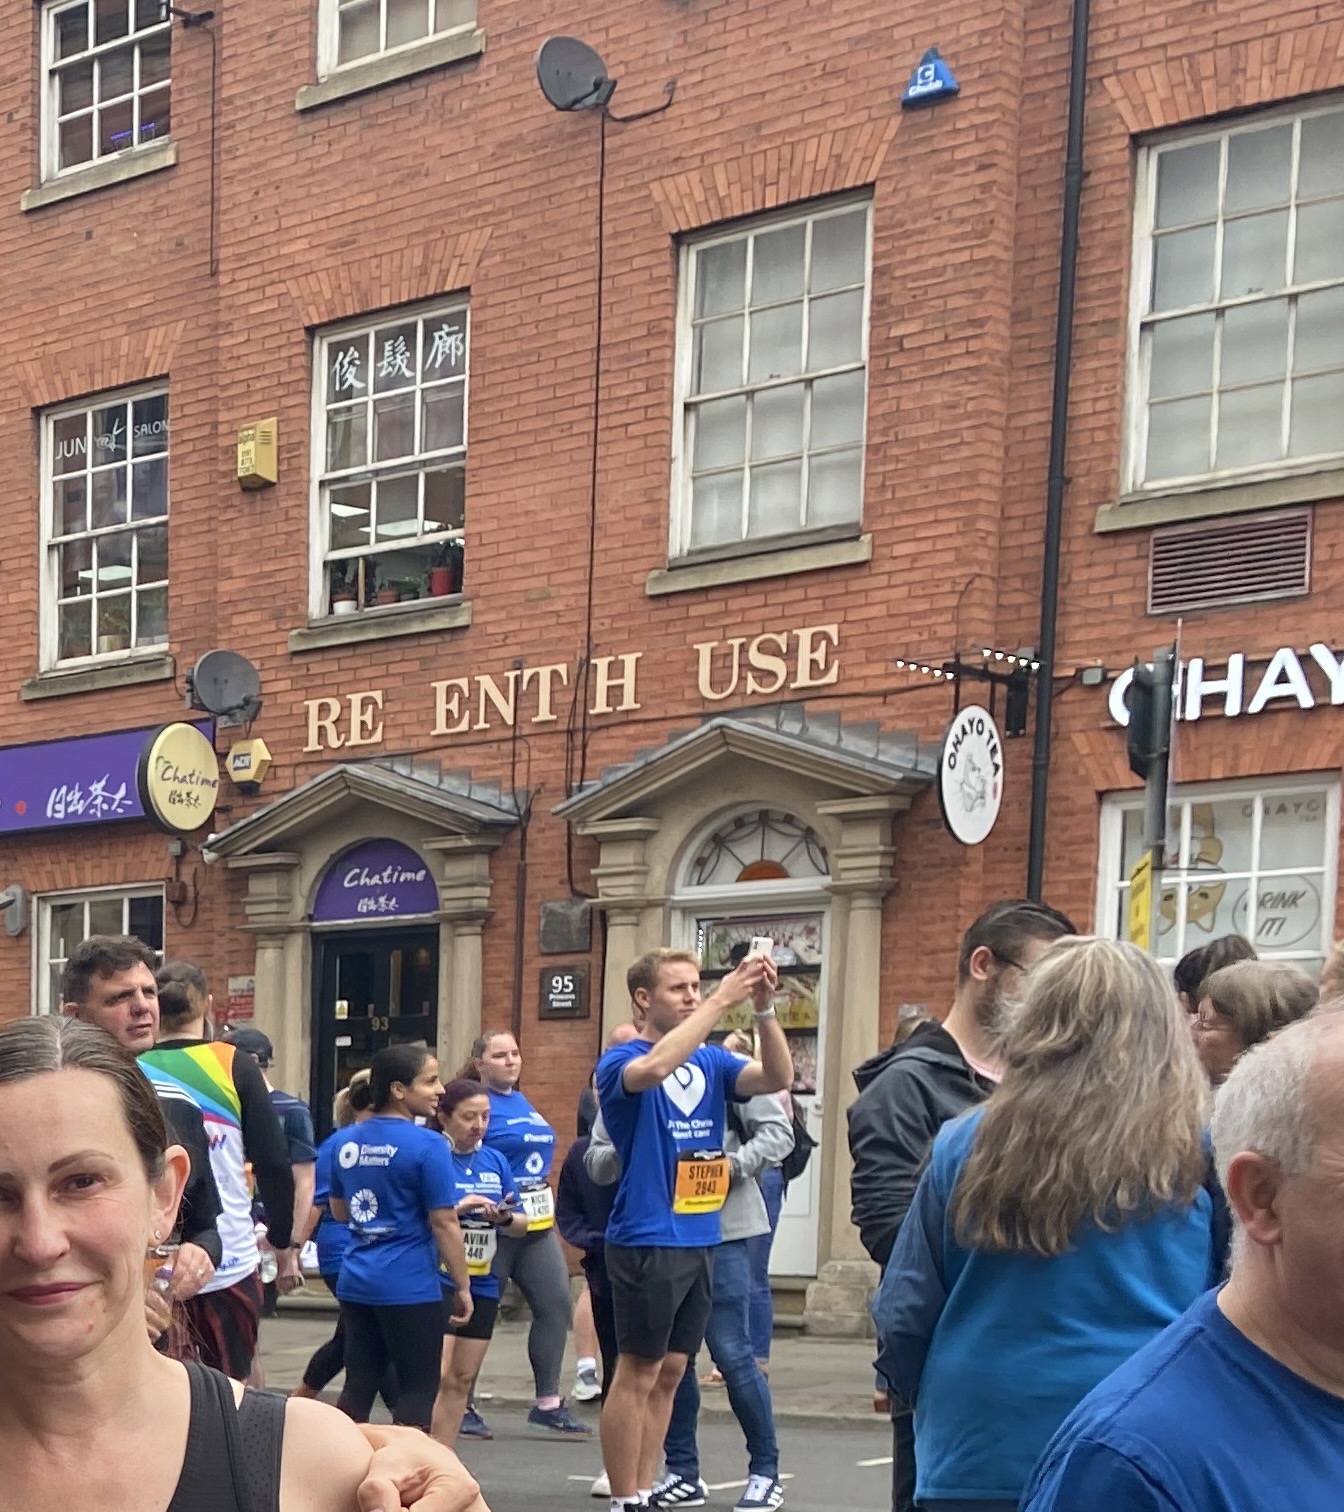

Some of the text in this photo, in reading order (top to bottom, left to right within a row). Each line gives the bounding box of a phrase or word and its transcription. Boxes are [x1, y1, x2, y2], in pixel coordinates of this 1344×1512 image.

[55, 435, 87, 461] JUN
[693, 624, 839, 701] USE
[948, 717, 1001, 777] OHAYO TEA
[161, 765, 218, 788] Chatime
[343, 865, 427, 888] Chatime
[1243, 889, 1308, 912] RINK
[552, 975, 574, 993] 95
[372, 1016, 389, 1031] 93
[688, 1163, 724, 1180] STEPHEN
